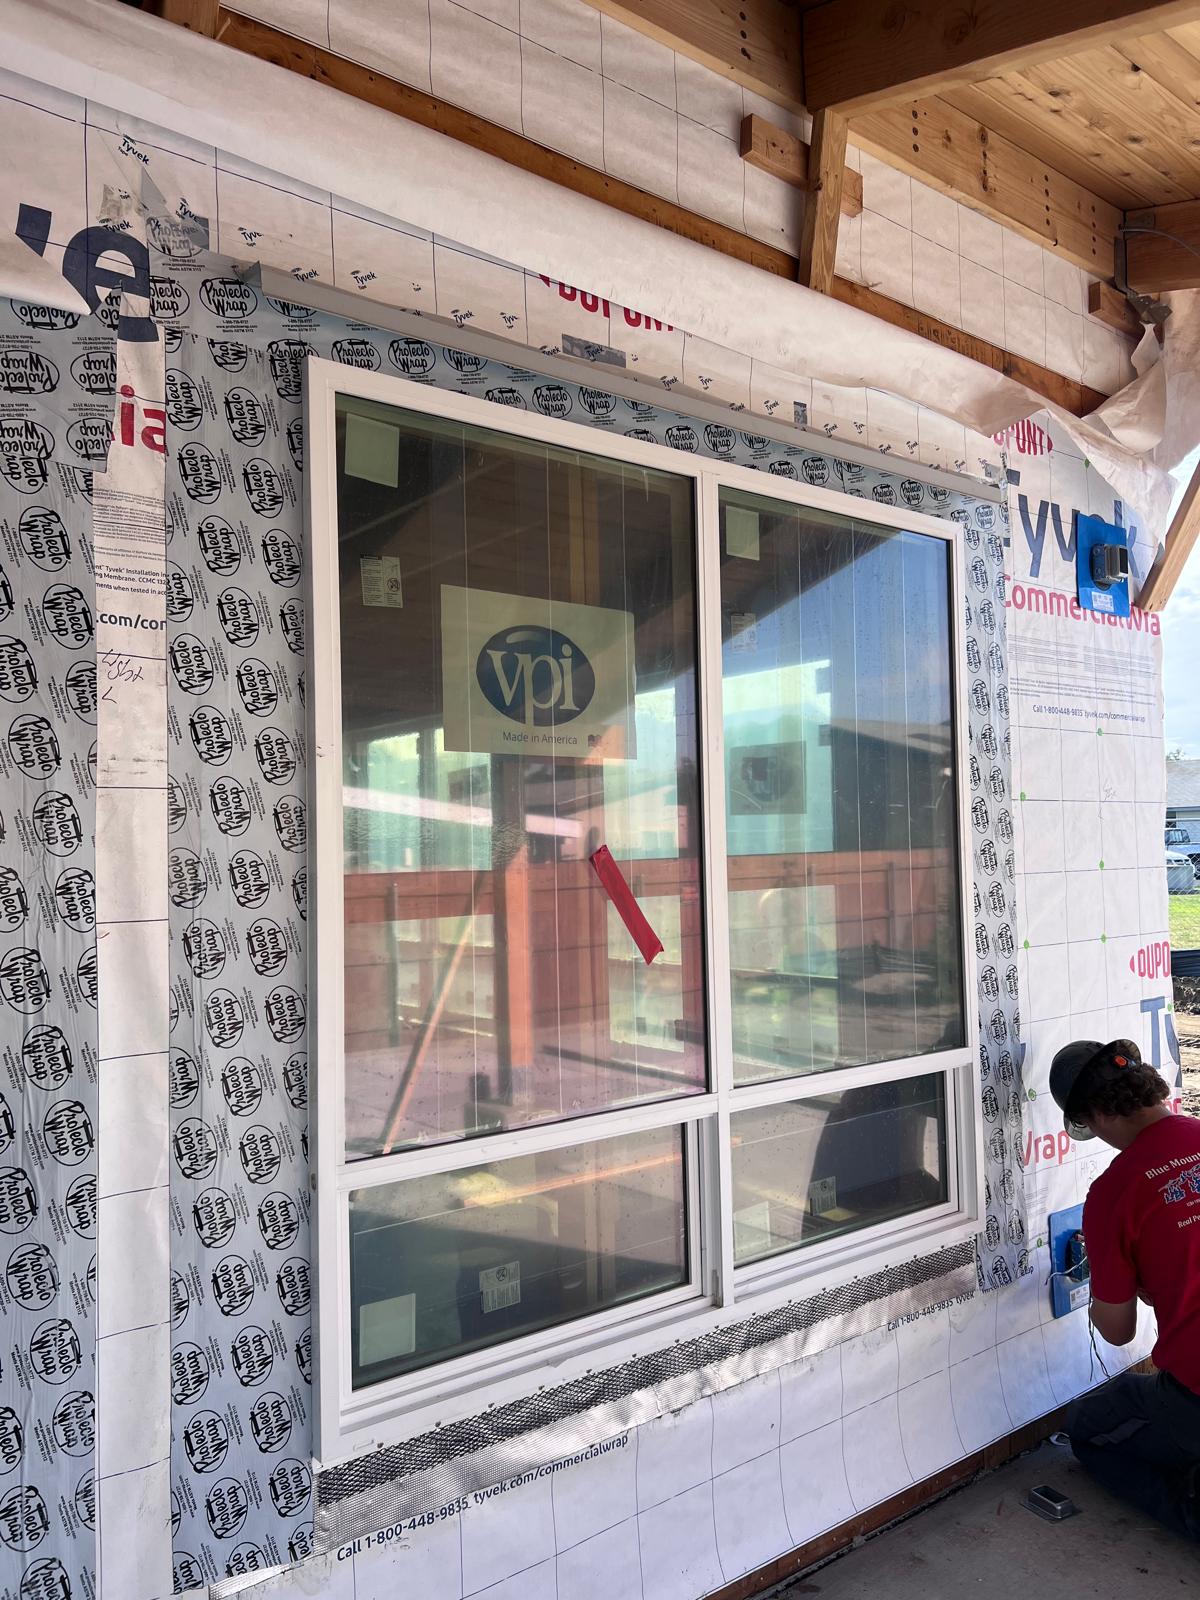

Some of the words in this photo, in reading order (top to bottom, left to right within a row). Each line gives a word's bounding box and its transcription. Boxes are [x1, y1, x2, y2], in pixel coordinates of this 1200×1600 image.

[120, 138, 150, 165] Tyvek
[103, 220, 132, 232] Tyvek
[201, 278, 250, 305] Protecto
[295, 269, 319, 282] Tyvek
[354, 272, 377, 284] Tyvek
[212, 298, 248, 318] Wrap
[453, 310, 475, 323] Tyvek
[0, 352, 45, 371] Wrap
[332, 339, 374, 363] Protecto
[390, 338, 430, 363] Protecto
[397, 356, 428, 373] Wrap
[452, 352, 481, 371] Wrap
[534, 385, 568, 405] Protecto
[662, 376, 679, 388] Tyvek
[224, 394, 257, 443] Protecto
[246, 399, 266, 435] Wrap
[541, 402, 566, 417] Wrap
[585, 400, 610, 415] Wrap
[666, 425, 694, 447] Protecto
[704, 424, 732, 442] Protecto
[711, 440, 730, 453] Wrap
[179, 449, 211, 500] Protecto
[200, 454, 220, 491] Wrap
[802, 457, 826, 473] Protecto
[809, 471, 825, 485] Wrap
[907, 492, 921, 505] Wrap
[19, 520, 45, 558] Wrap
[29, 510, 72, 563] Protecto
[198, 522, 230, 573] Protecto
[220, 527, 240, 564] Wrap
[126, 568, 160, 577] Installation
[972, 564, 980, 586] Wrap
[43, 597, 68, 636] Wrap
[53, 587, 94, 641] Protecto
[218, 594, 249, 644] Protecto
[239, 598, 258, 635] Wrap
[171, 641, 202, 692] Protecto
[192, 645, 212, 683] Wrap
[237, 666, 267, 714] Protecto
[258, 669, 277, 706] Wrap
[487, 644, 580, 727] vpi
[972, 688, 981, 710] Wrap
[1033, 705, 1042, 713] Call
[8, 728, 34, 767] Wrap
[18, 718, 61, 772] Protecto
[503, 732, 529, 743] Made
[531, 733, 540, 744] in
[542, 734, 578, 746] America
[981, 732, 990, 754] Wrap
[990, 773, 998, 796] Wrap
[33, 805, 58, 844] Wrap
[43, 795, 84, 849] Protecto
[209, 784, 240, 834] Protecto
[230, 787, 250, 825] Wrap
[972, 805, 980, 828] Wrap
[980, 847, 989, 870] Wrap
[990, 890, 998, 912] Wrap
[247, 926, 276, 975] Protecto
[268, 928, 287, 966] Wrap
[998, 930, 1006, 952] Wrap
[0, 961, 24, 1001] Wrap
[9, 951, 51, 1006] Protecto
[982, 974, 990, 996] Wrap
[266, 993, 294, 1041] Protecto
[286, 995, 305, 1032] Wrap
[991, 1017, 1000, 1040] Wrap
[22, 1038, 48, 1078] Wrap
[32, 1028, 74, 1083] Protecto
[982, 1094, 990, 1116] Wrap
[44, 1114, 70, 1153] Wrap
[54, 1104, 96, 1158] Protecto
[241, 1134, 268, 1183] Protecto
[261, 1134, 280, 1173] Wrap
[1145, 1164, 1170, 1180] Blue
[1178, 1216, 1192, 1228] Real
[6, 1257, 33, 1297] Wrap
[17, 1247, 61, 1302] Protecto
[213, 1264, 241, 1315] Protecto
[234, 1264, 253, 1305] Wrap
[887, 1319, 900, 1332] Call
[30, 1333, 56, 1372] Wrap
[40, 1323, 82, 1377] Protecto
[232, 1335, 260, 1385] Protecto
[253, 1335, 272, 1376] Wrap
[207, 1488, 234, 1537] Protecto
[228, 1486, 247, 1528] Wrap
[337, 1540, 362, 1561] Call
[365, 1496, 469, 1550] 1-800-448-9835
[473, 1434, 629, 1504] tyvek.com/commercialwrap
[0, 1499, 24, 1539] Wrap
[8, 1489, 51, 1544] Protecto
